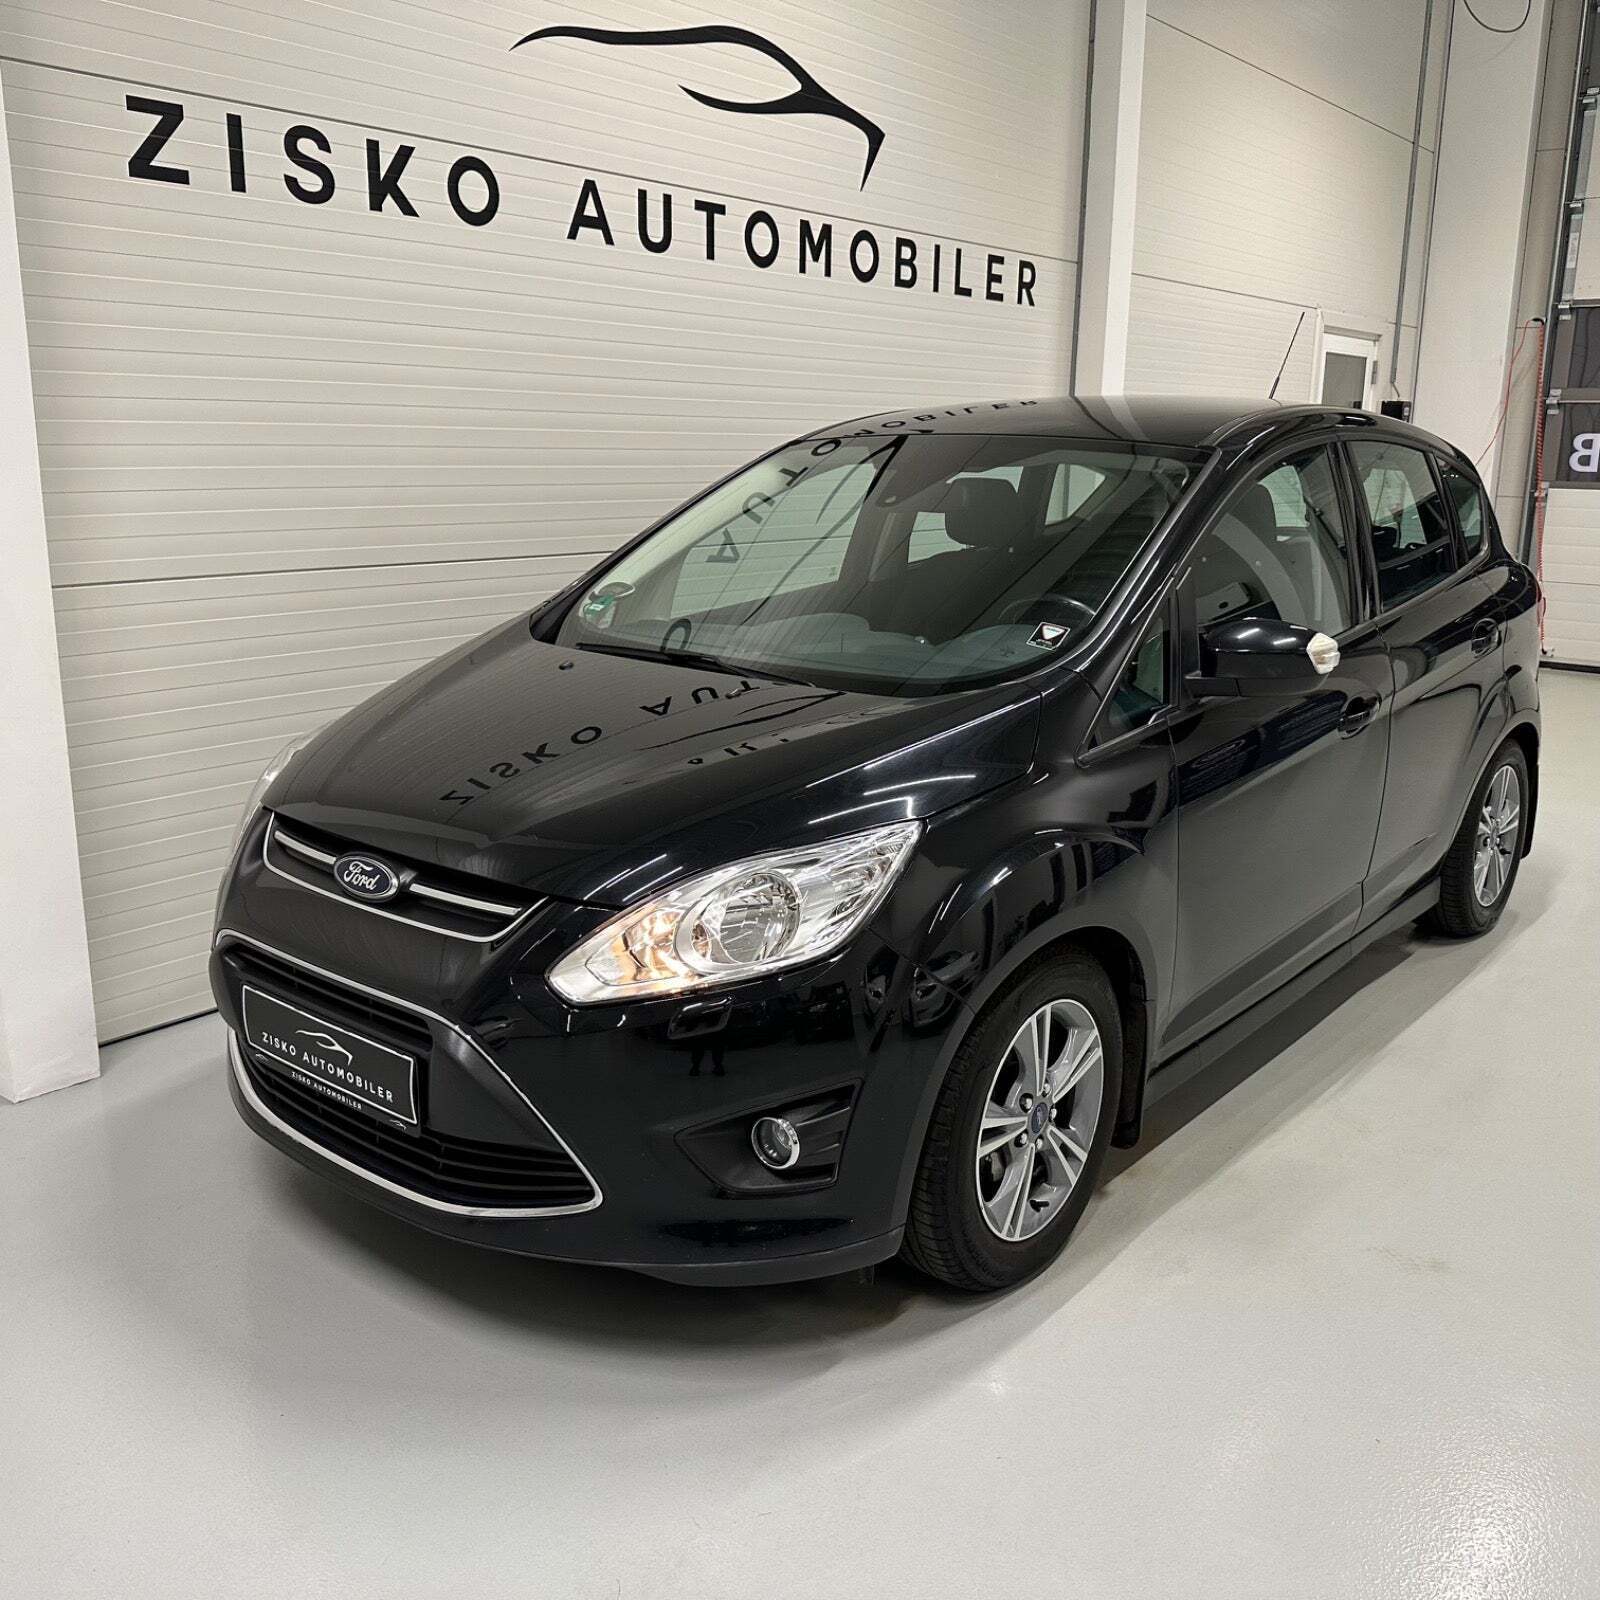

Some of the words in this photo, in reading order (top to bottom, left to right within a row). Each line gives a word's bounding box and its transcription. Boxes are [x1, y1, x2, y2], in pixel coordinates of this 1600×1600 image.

[125, 94, 500, 227] ZISKO
[566, 178, 1037, 307] AUTOMOBILER
[343, 860, 381, 890] Ford
[261, 1031, 297, 1056] ZISKO
[302, 1051, 394, 1103] AUTOMOBILER
